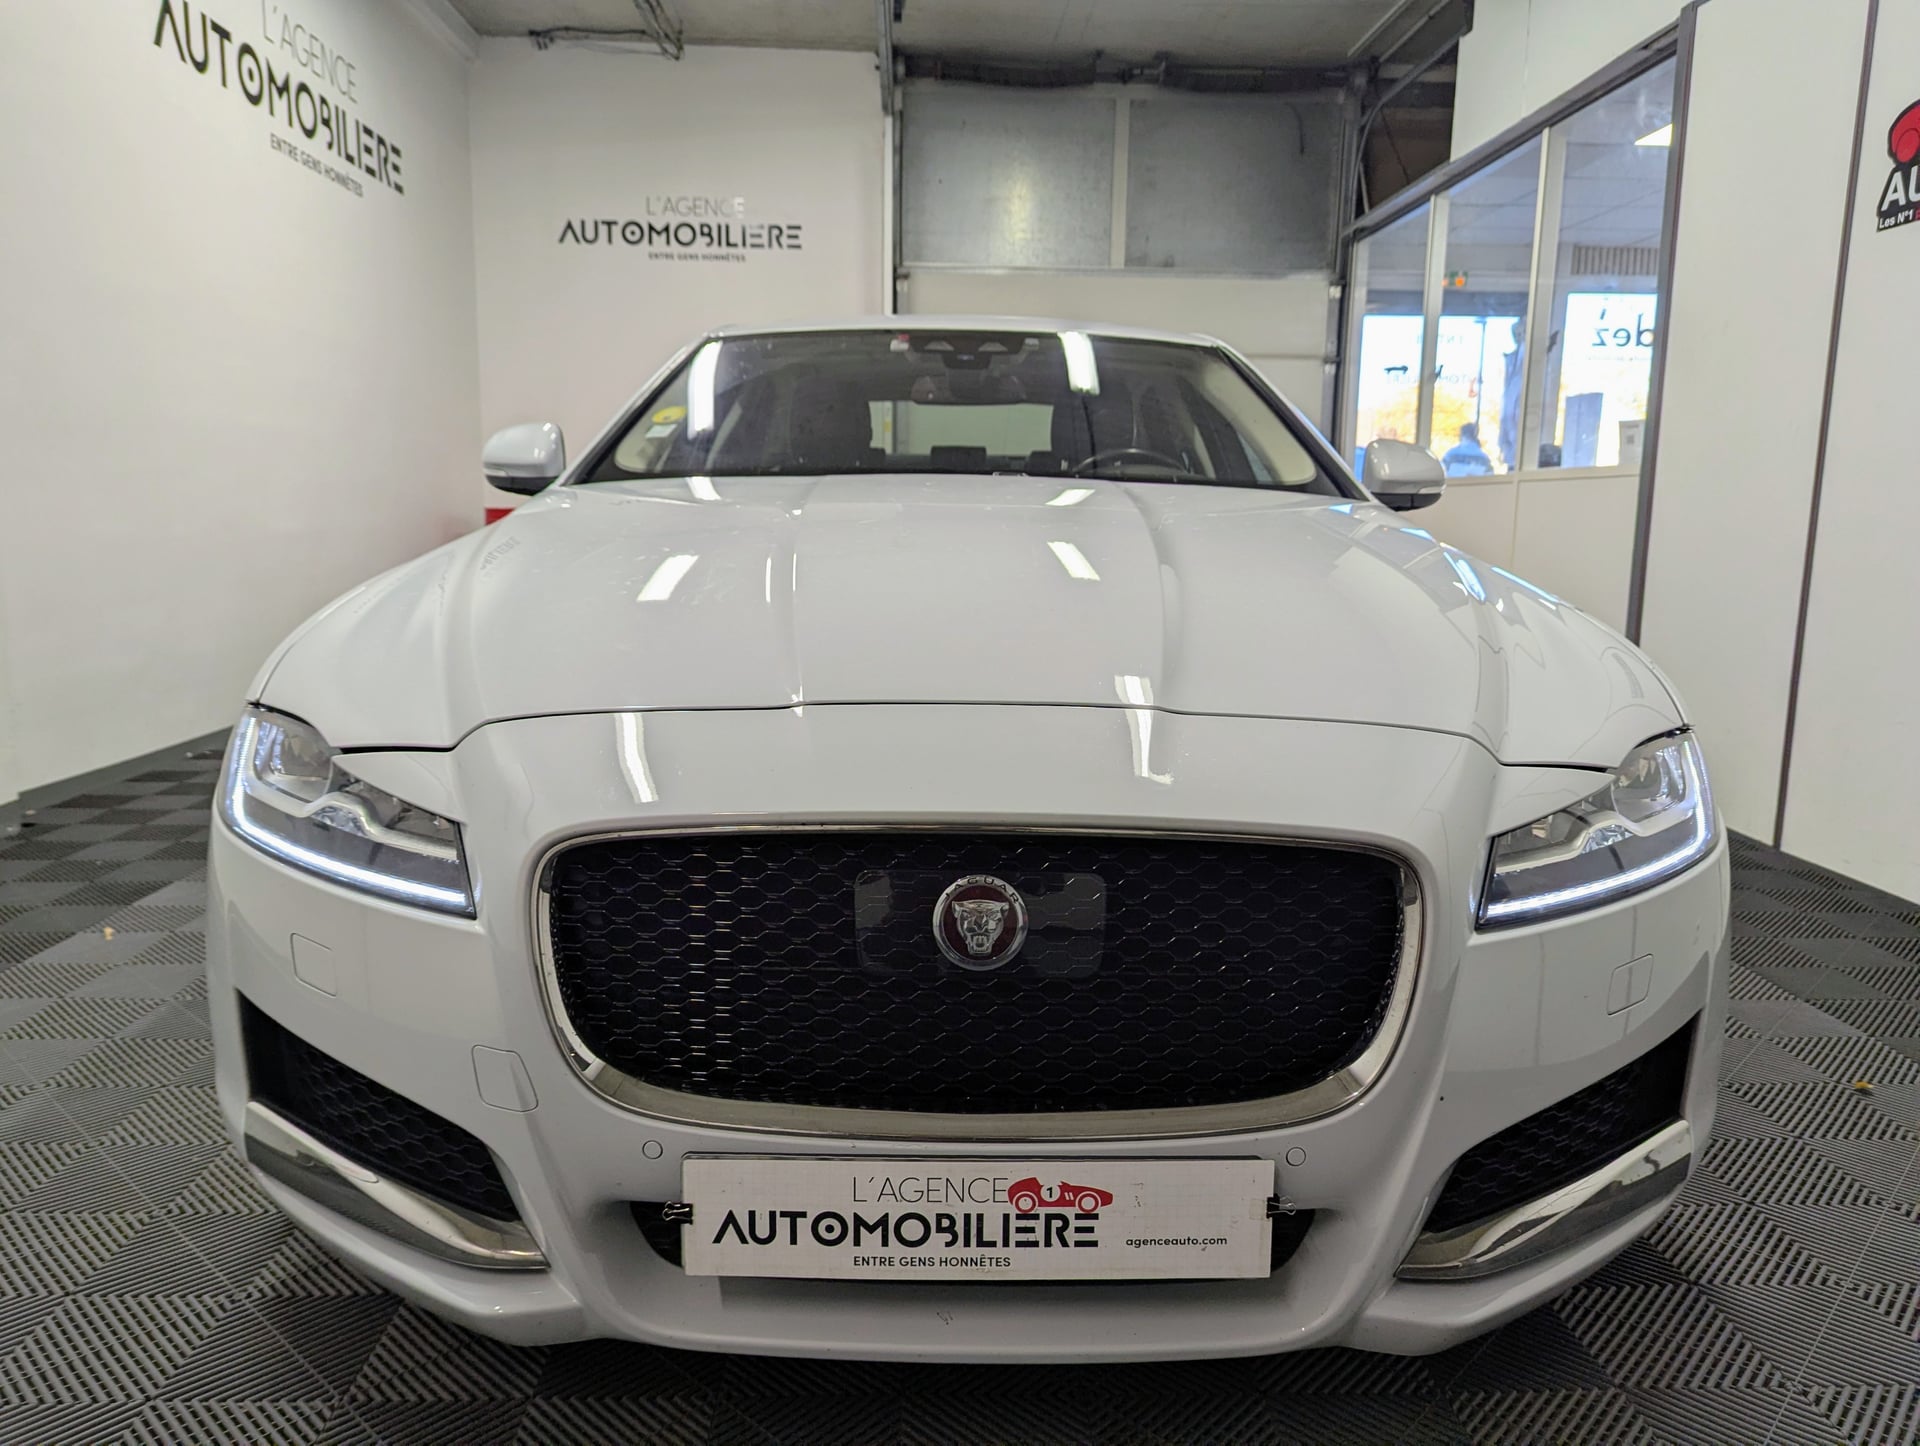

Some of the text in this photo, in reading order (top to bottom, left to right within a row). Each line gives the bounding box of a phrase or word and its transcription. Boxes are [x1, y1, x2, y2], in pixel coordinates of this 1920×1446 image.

[261, 0, 358, 104] L'AGENCE
[153, 0, 405, 195] AUTOMOBILIERE
[270, 132, 299, 162] ENTRE
[300, 150, 323, 175] GENS
[645, 196, 745, 218] L'AGENCE
[558, 219, 802, 250] AUTOMOBILIERE
[1879, 216, 1896, 229] Les
[852, 1176, 1009, 1204] L'AGENCE
[1046, 1186, 1053, 1199] 1
[711, 1209, 1100, 1249] AUTOMOBILIERE
[1125, 1236, 1228, 1249] agenceauto.com
[853, 1253, 1012, 1268] ENTRE GENS HONNÊTES
